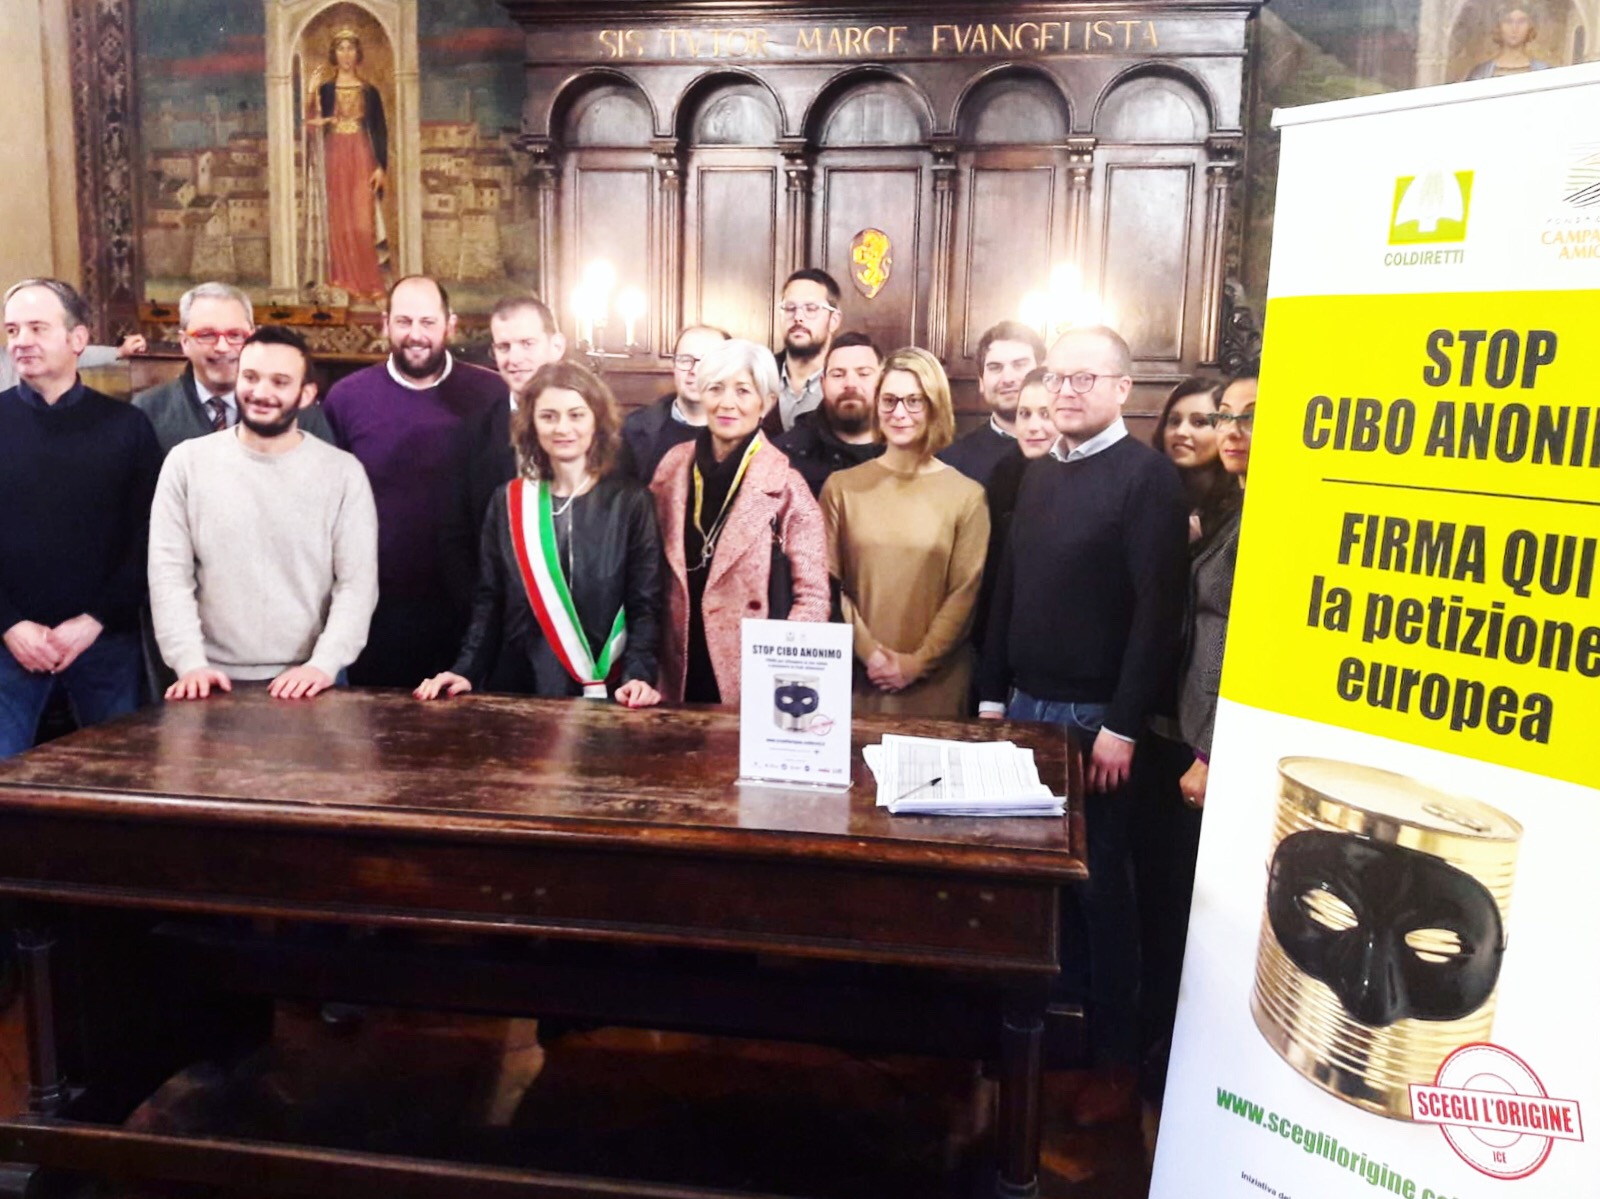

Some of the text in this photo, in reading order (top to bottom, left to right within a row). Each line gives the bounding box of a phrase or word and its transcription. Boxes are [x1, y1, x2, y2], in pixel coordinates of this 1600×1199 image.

[599, 29, 643, 58] SIS
[931, 20, 1158, 53] EVANGELISTA
[1384, 249, 1464, 266] COLDIRETTI
[1423, 329, 1558, 389] STOP
[1302, 395, 1600, 468] CIBO ANONI
[1337, 511, 1597, 598] FIRMA QUI
[1306, 575, 1600, 678] la petizione
[752, 645, 842, 659] STOP CIBO ANONIMO
[1336, 656, 1554, 745] europea
[1417, 1091, 1574, 1133] SCEGLI L'ORIGINE
[1493, 1151, 1507, 1164] ICE
[1241, 1171, 1276, 1196] Iniziativa
